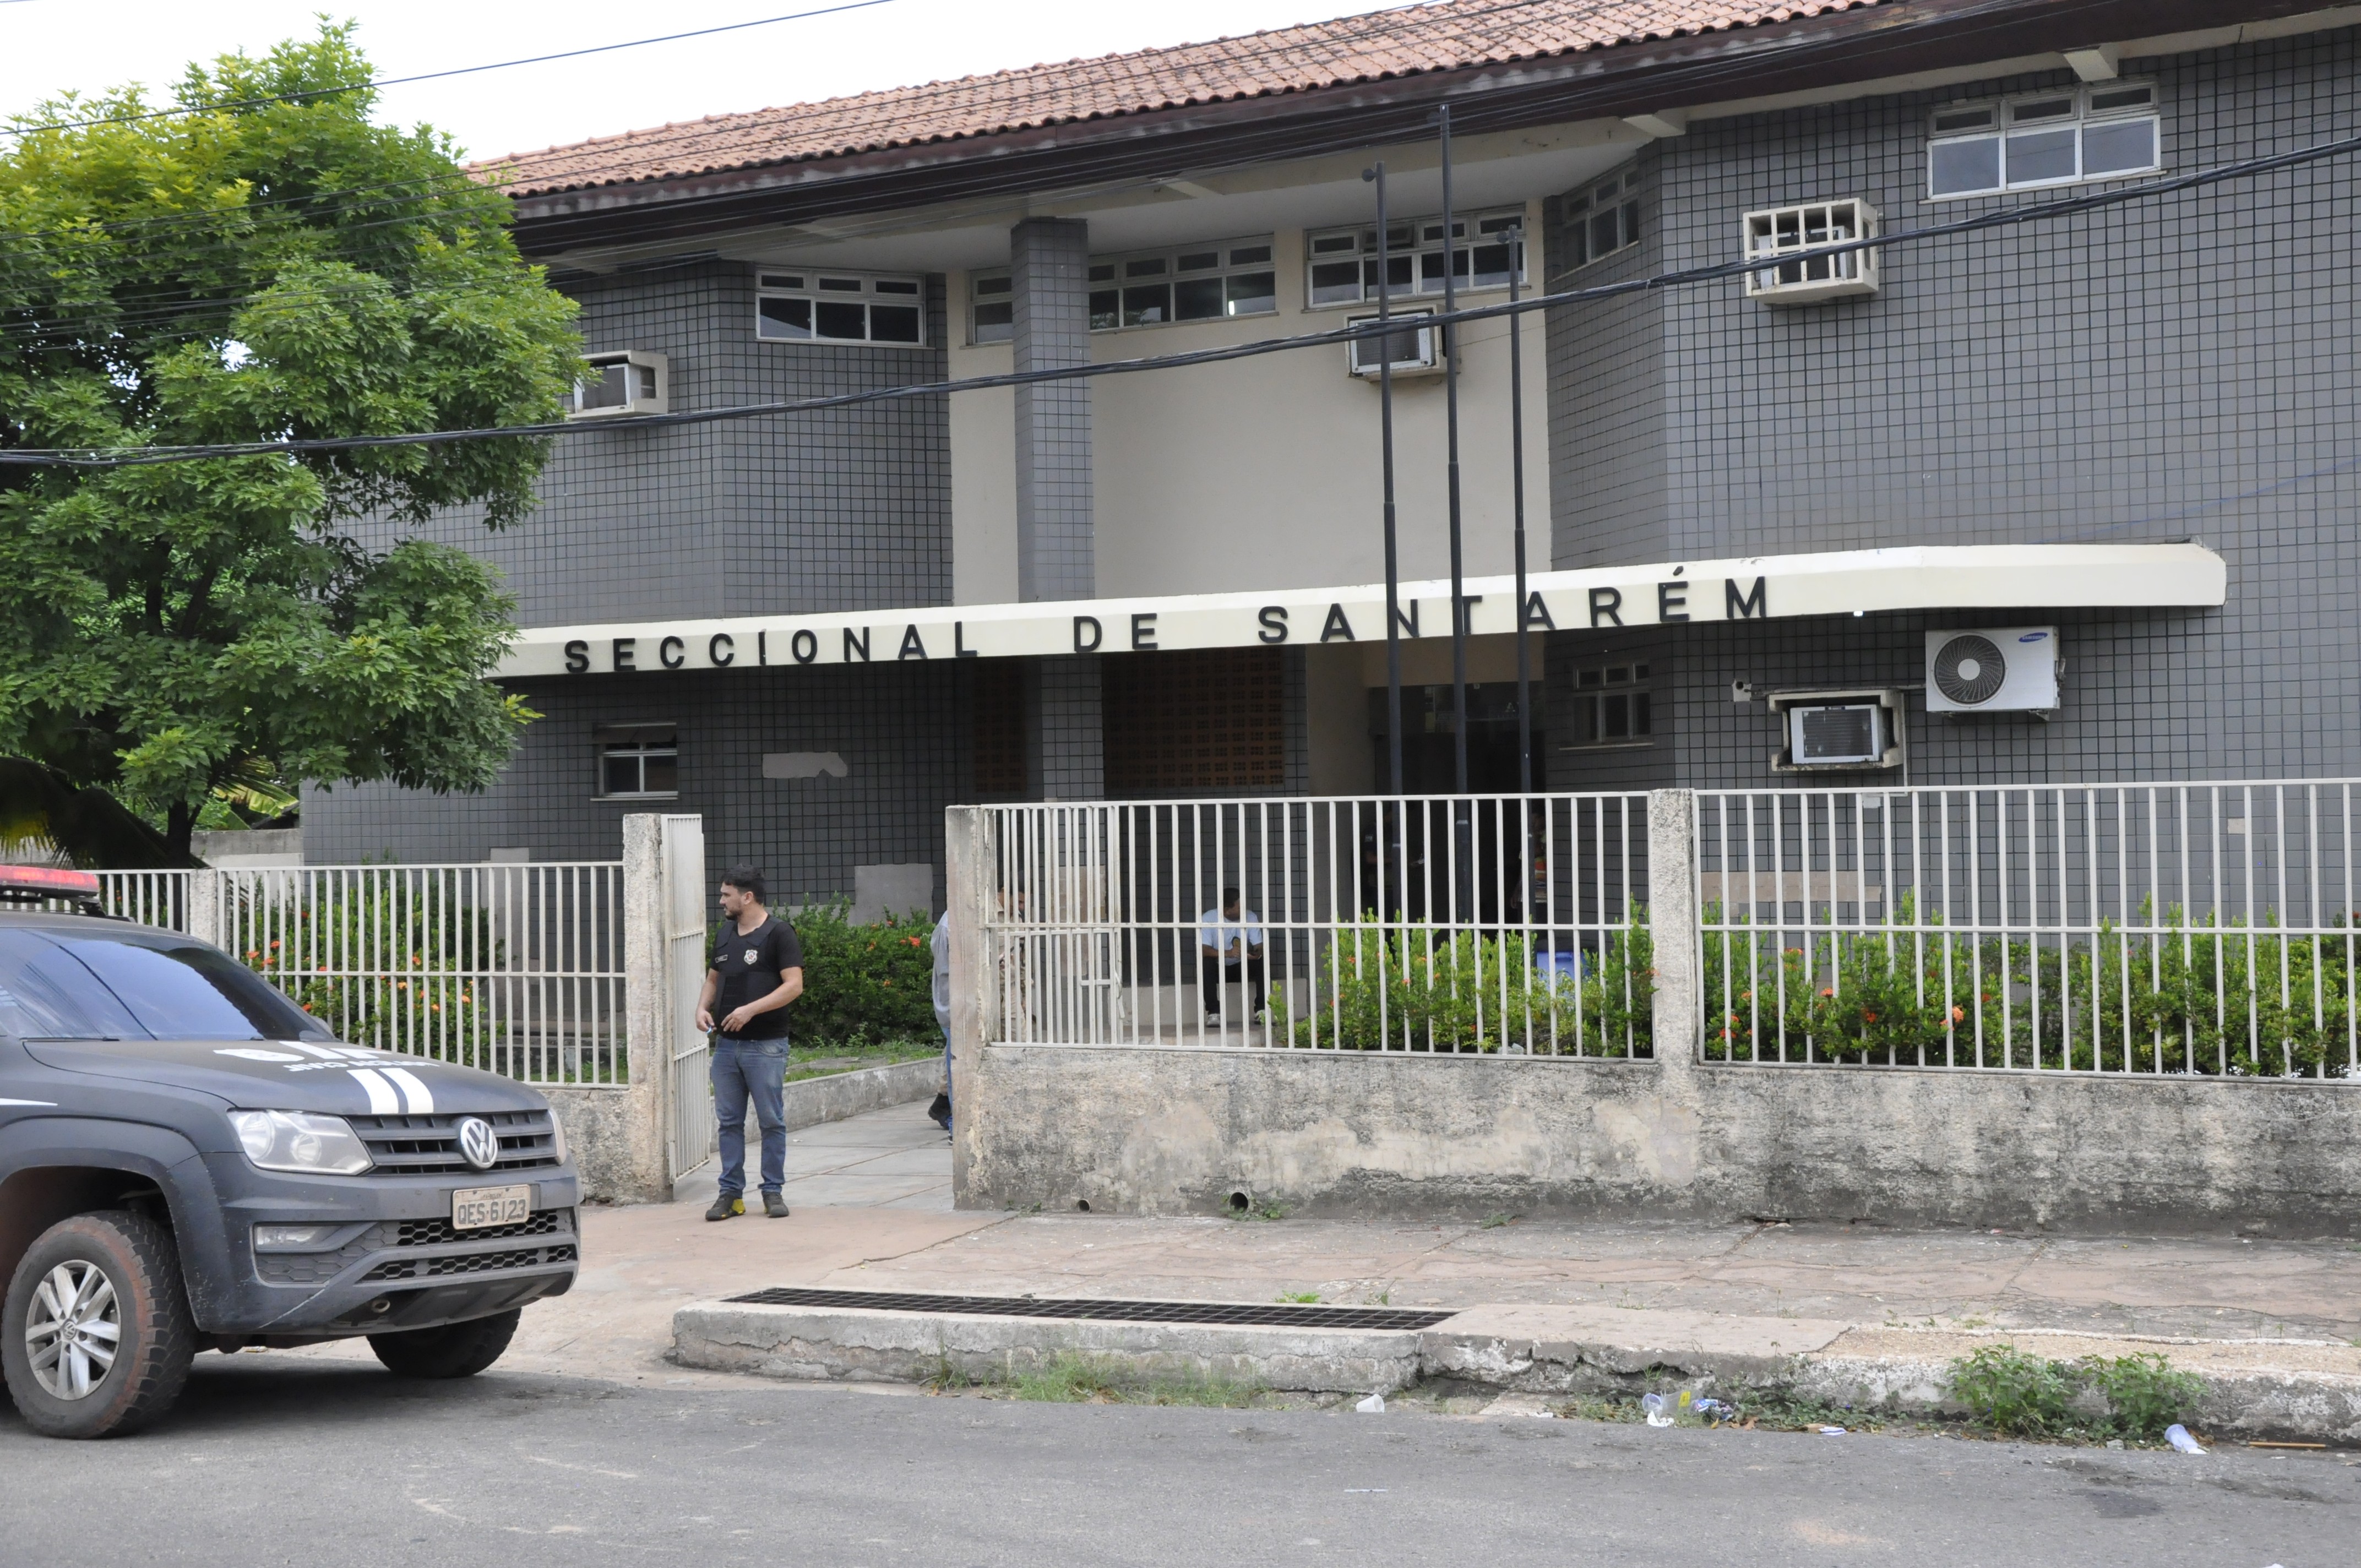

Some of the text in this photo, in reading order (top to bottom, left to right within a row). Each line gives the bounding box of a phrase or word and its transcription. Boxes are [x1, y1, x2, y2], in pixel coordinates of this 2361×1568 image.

[564, 566, 1767, 673] SECCIONAL DE SANTARÉM
